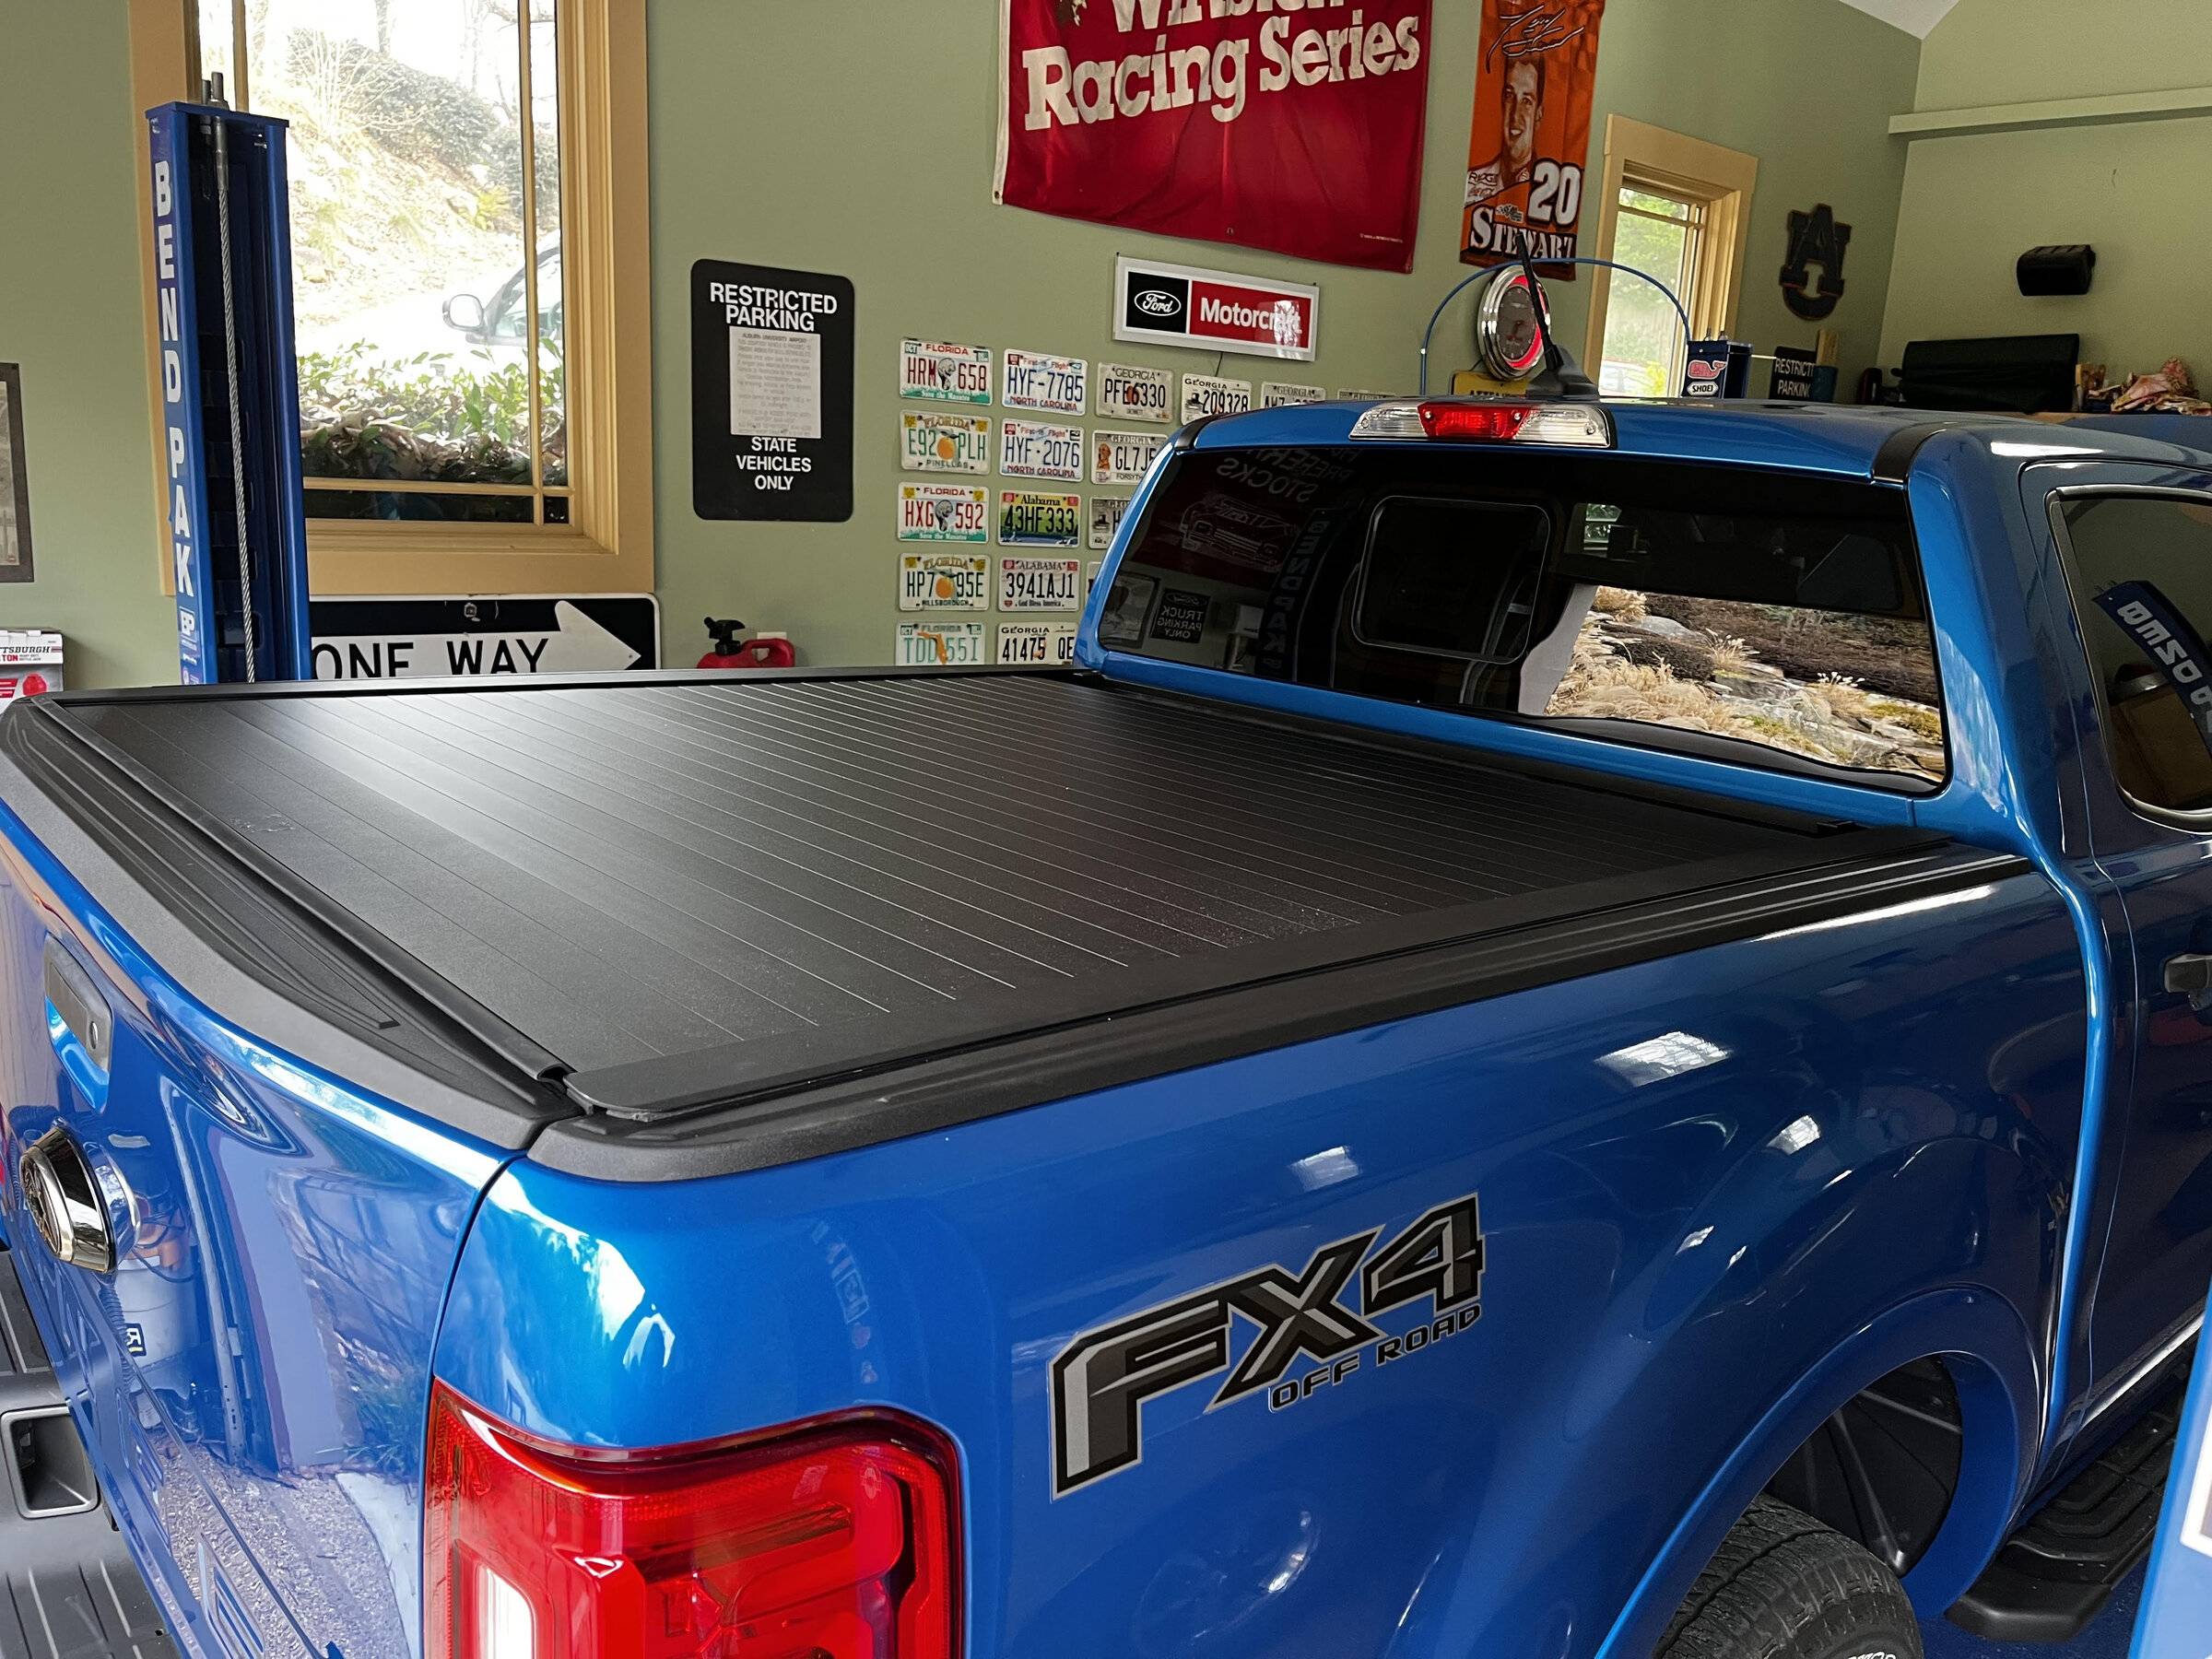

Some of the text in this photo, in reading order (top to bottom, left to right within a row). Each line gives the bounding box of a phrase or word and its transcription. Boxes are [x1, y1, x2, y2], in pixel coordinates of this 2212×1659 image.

[1022, 35, 1249, 131] Racing
[1259, 8, 1420, 92] Series
[1527, 160, 1581, 226] 20
[1470, 206, 1574, 262] STEWART
[710, 282, 838, 314] RESTRICTED
[1142, 293, 1173, 313] Ford
[725, 305, 815, 332] PARKING
[925, 344, 970, 355] FLORIDA
[155, 160, 194, 597] BEND PAK
[907, 357, 987, 392] HRM 658
[1007, 366, 1084, 402] HYF-7785
[1114, 369, 1156, 381] GEORGIA
[1184, 378, 1228, 389] GEORGIA
[1010, 396, 1077, 412] NORTH CAROLINA
[1277, 386, 1313, 397] GEORGIA
[923, 416, 971, 432] FLORIDA
[751, 437, 797, 453] STATE
[908, 429, 986, 461] E92 PLH
[1111, 435, 1152, 444] GEORGIA
[736, 455, 812, 473] VEHICLES
[1006, 465, 1076, 478] NORTH CAROLINA
[755, 475, 794, 491] ONLY
[924, 487, 966, 496] FLORIDA
[1021, 494, 1061, 506] Alabama
[905, 500, 983, 530] HXG 592
[1004, 504, 1075, 533] 43HF333
[923, 557, 970, 571] FLORIDA
[1018, 559, 1063, 571] ALABAMA
[907, 571, 984, 597] HP7 95E
[1006, 571, 1076, 599] 3941AJ1
[312, 638, 549, 679] ONE WAY
[1002, 637, 1046, 662] 41475
[1048, 1192, 1486, 1501] FX4
[1268, 1302, 1483, 1413] OFF ROAD
